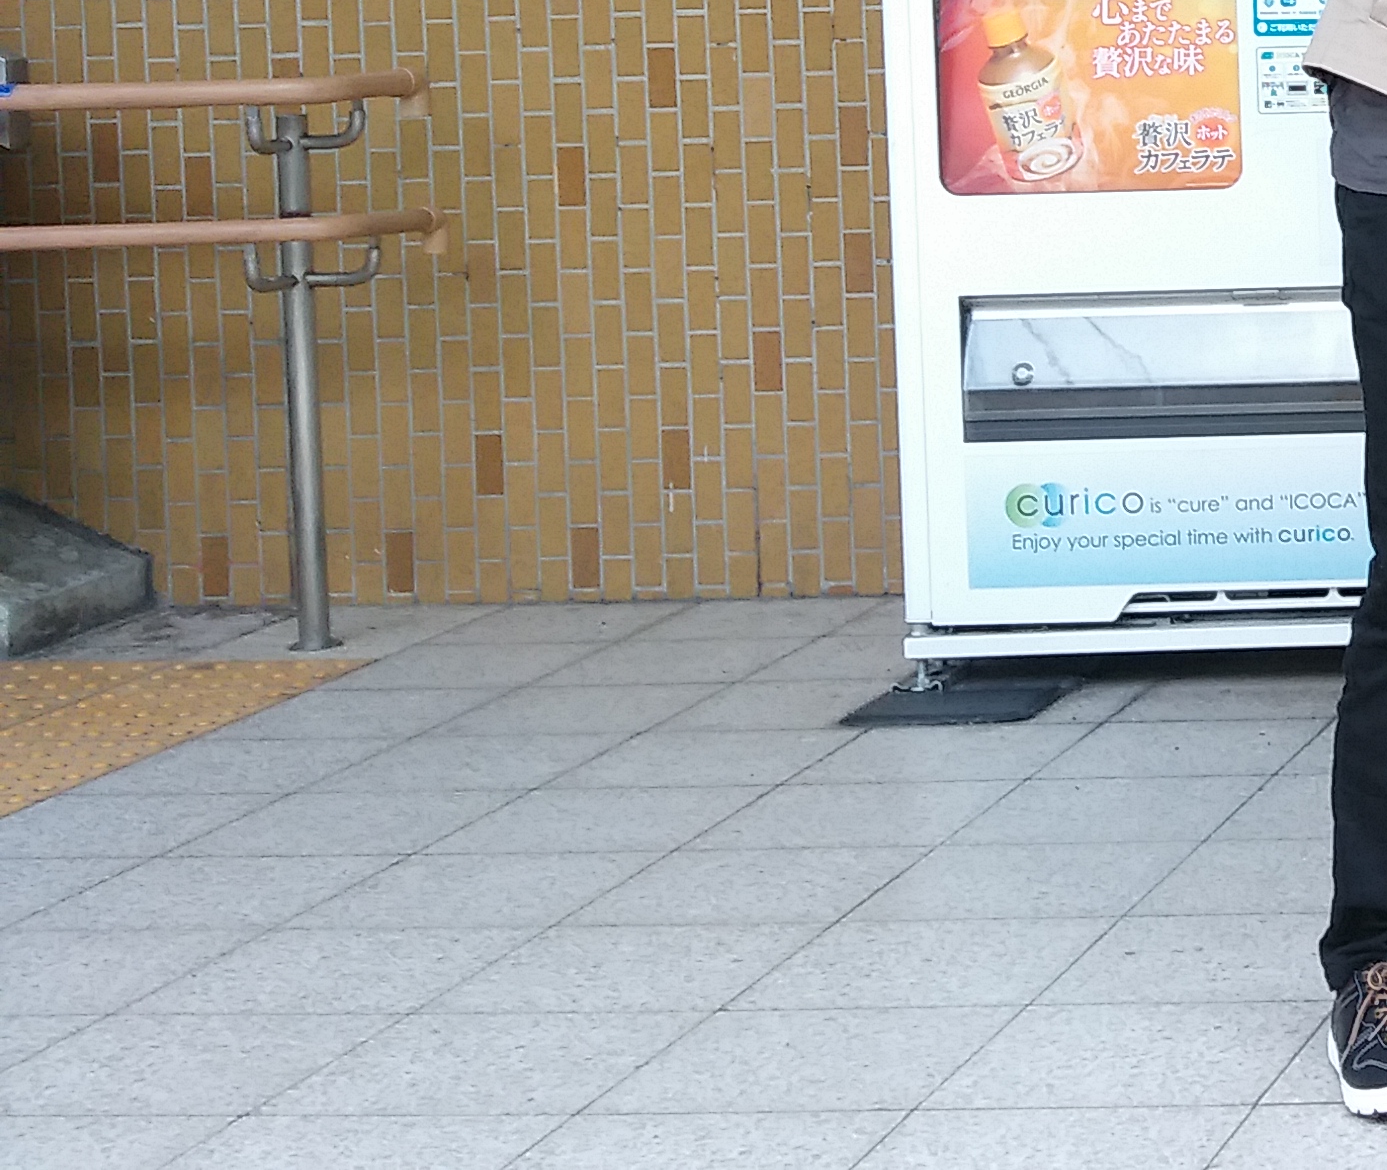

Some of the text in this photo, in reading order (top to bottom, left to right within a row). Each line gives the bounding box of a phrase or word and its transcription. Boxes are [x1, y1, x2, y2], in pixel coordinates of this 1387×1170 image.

[1117, 18, 1236, 47] あたたまる
[1091, 45, 1206, 79] 贅沢な味
[1003, 77, 1050, 100] GEORGIA
[1002, 108, 1043, 133] 贅沢
[1010, 118, 1066, 147] カフェラ
[1136, 121, 1229, 148] 贅沢 ホット
[1136, 148, 1234, 172] カフェラテ
[1016, 487, 1145, 517] curico
[1150, 498, 1162, 513] is
[1235, 494, 1274, 512] and
[1012, 533, 1061, 554] Enjoy
[1067, 534, 1108, 552] your
[1113, 527, 1181, 551] special
[1187, 528, 1229, 546] time
[1234, 527, 1274, 544] with
